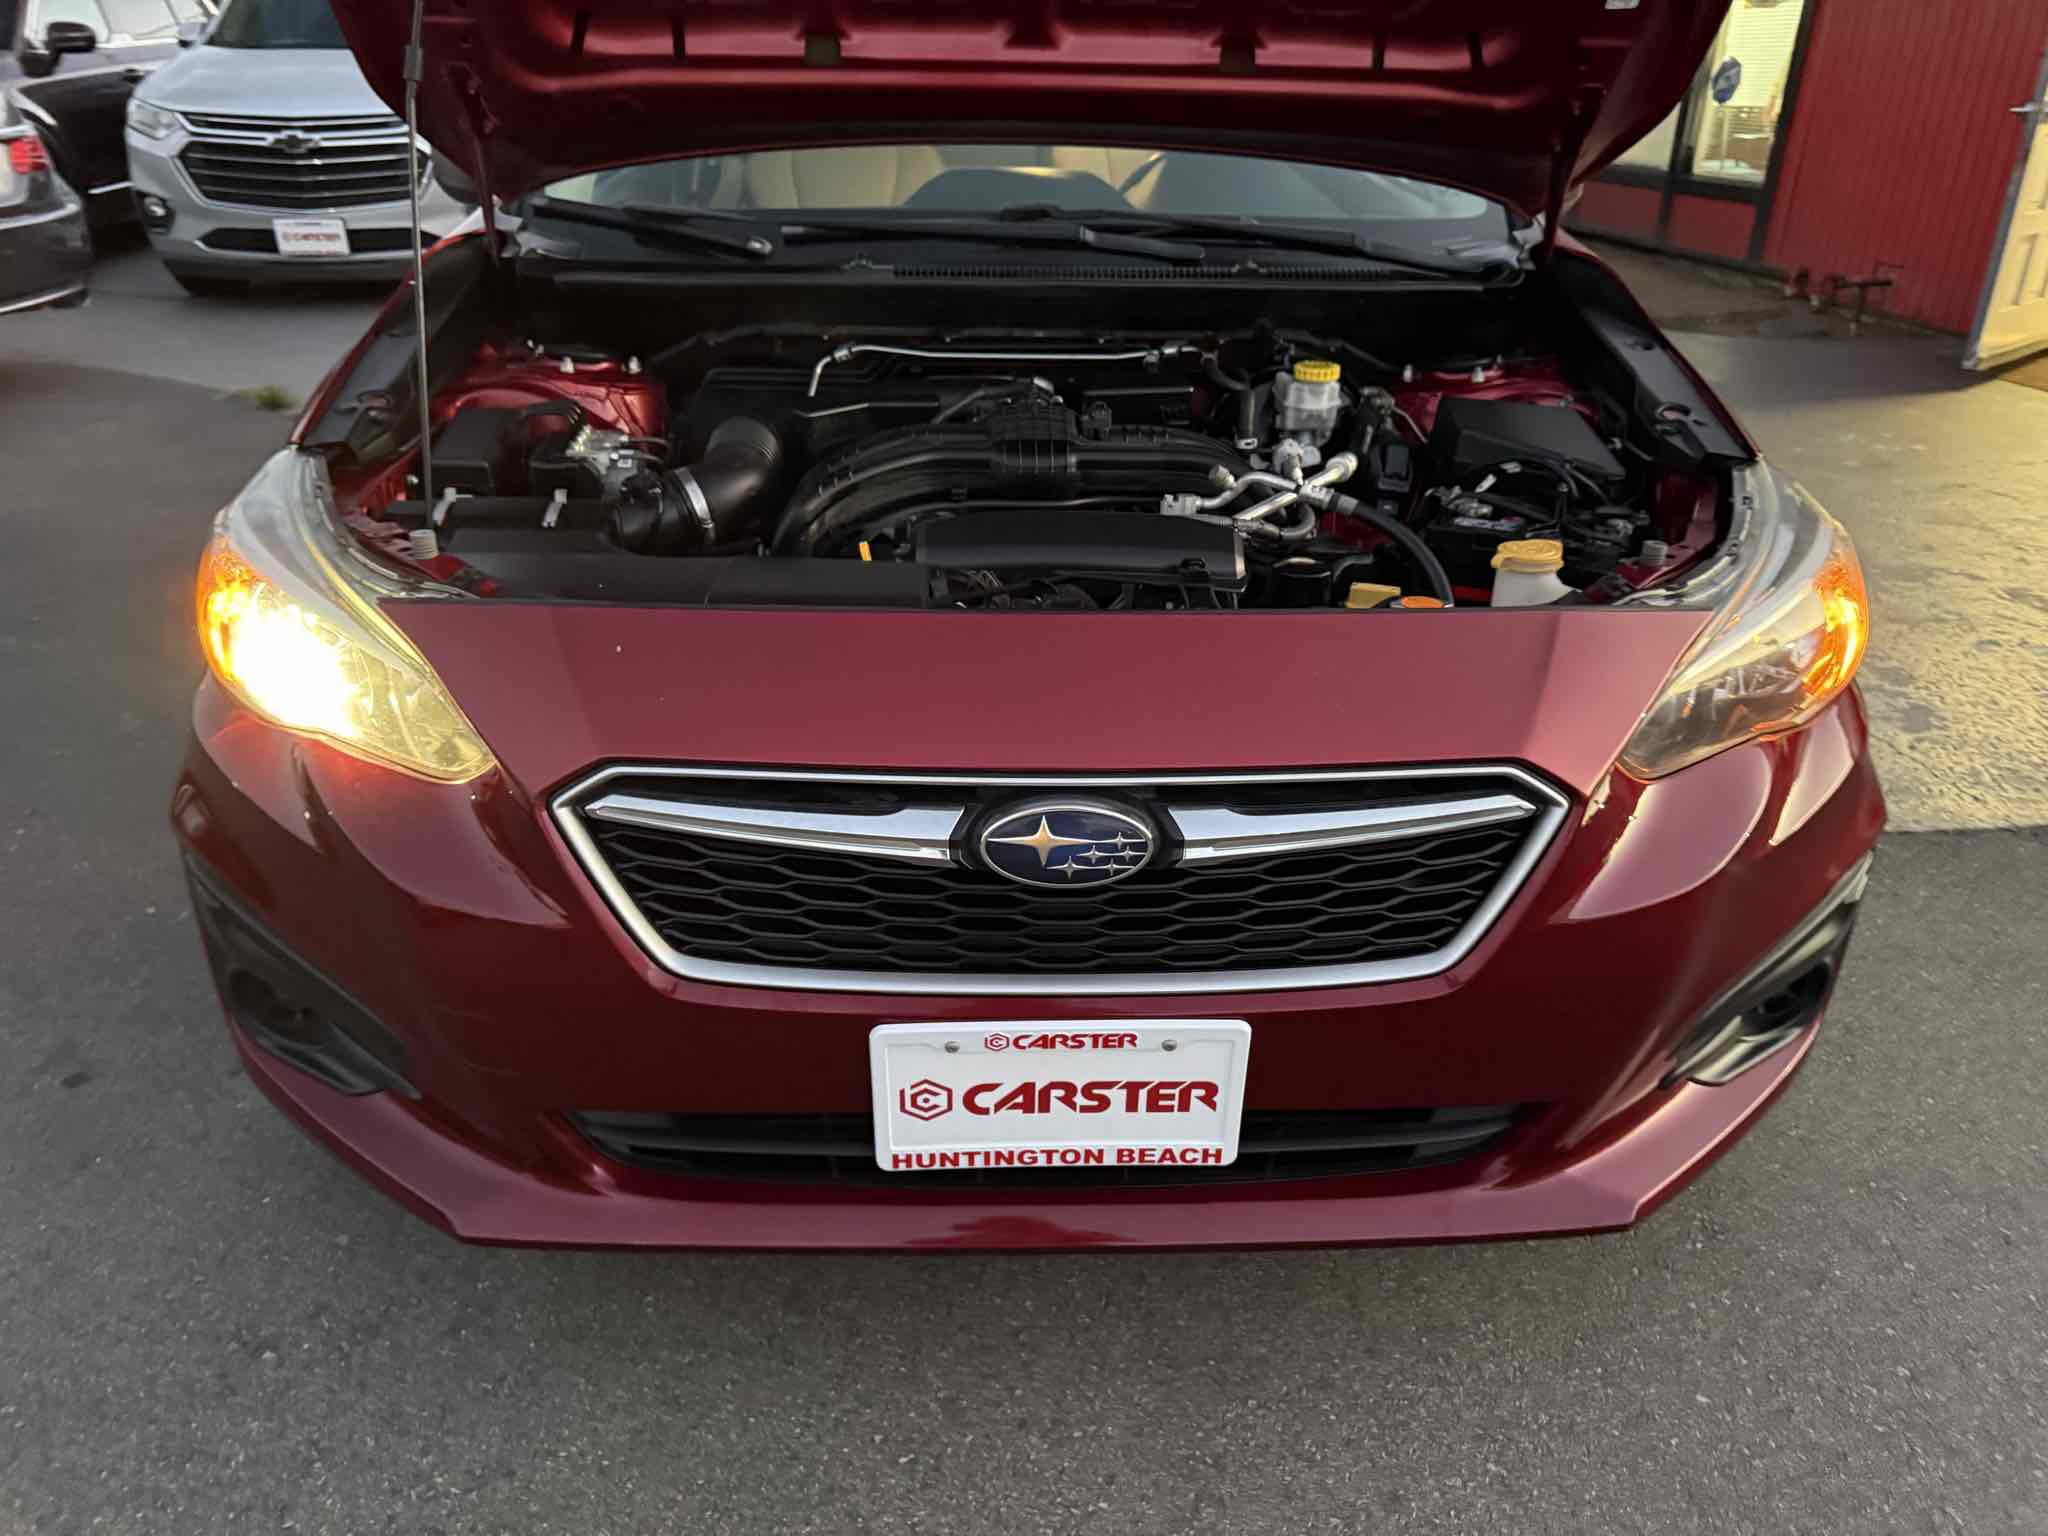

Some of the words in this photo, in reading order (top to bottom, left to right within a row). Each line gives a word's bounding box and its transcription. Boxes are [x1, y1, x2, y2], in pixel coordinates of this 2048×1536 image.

[1012, 1032, 1138, 1051] CARSTER
[962, 1080, 1220, 1116] CARSTER
[891, 1148, 1104, 1169] HUNTINGTON
[1116, 1147, 1223, 1165] BEACH
